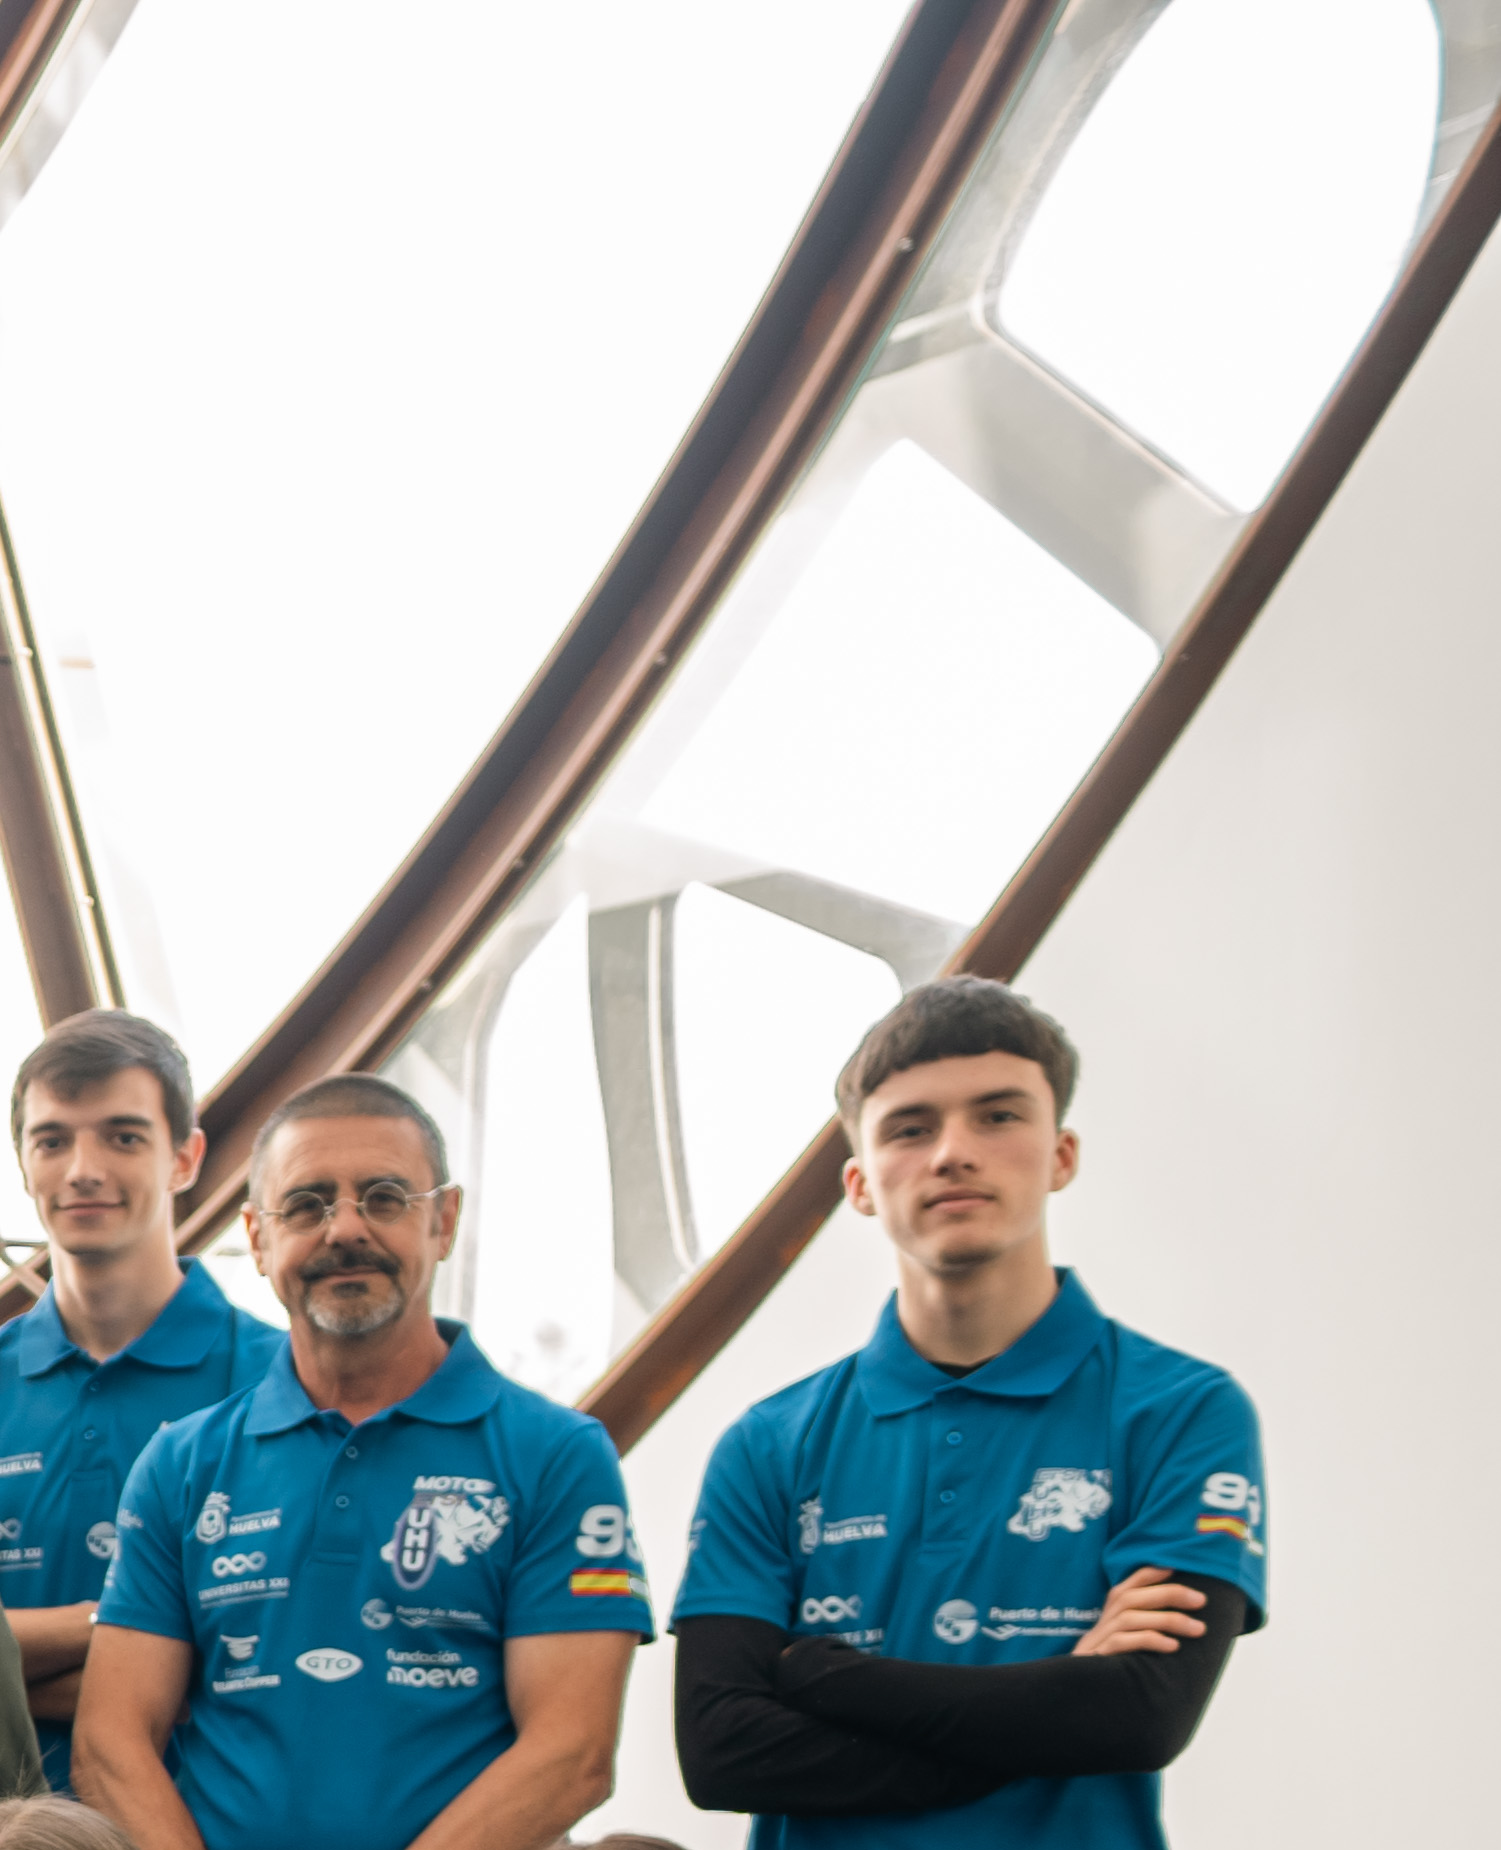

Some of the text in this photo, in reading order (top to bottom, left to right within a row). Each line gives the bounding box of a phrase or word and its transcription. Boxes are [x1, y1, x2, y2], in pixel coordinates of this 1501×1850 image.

[229, 1515, 280, 1536] HUELVA
[823, 1523, 888, 1545] HUELVA
[401, 1508, 430, 1572] UHU
[1041, 1606, 1061, 1620] de
[1064, 1607, 1101, 1621] Huel
[306, 1656, 353, 1670] GTO
[387, 1666, 479, 1688] moeve
